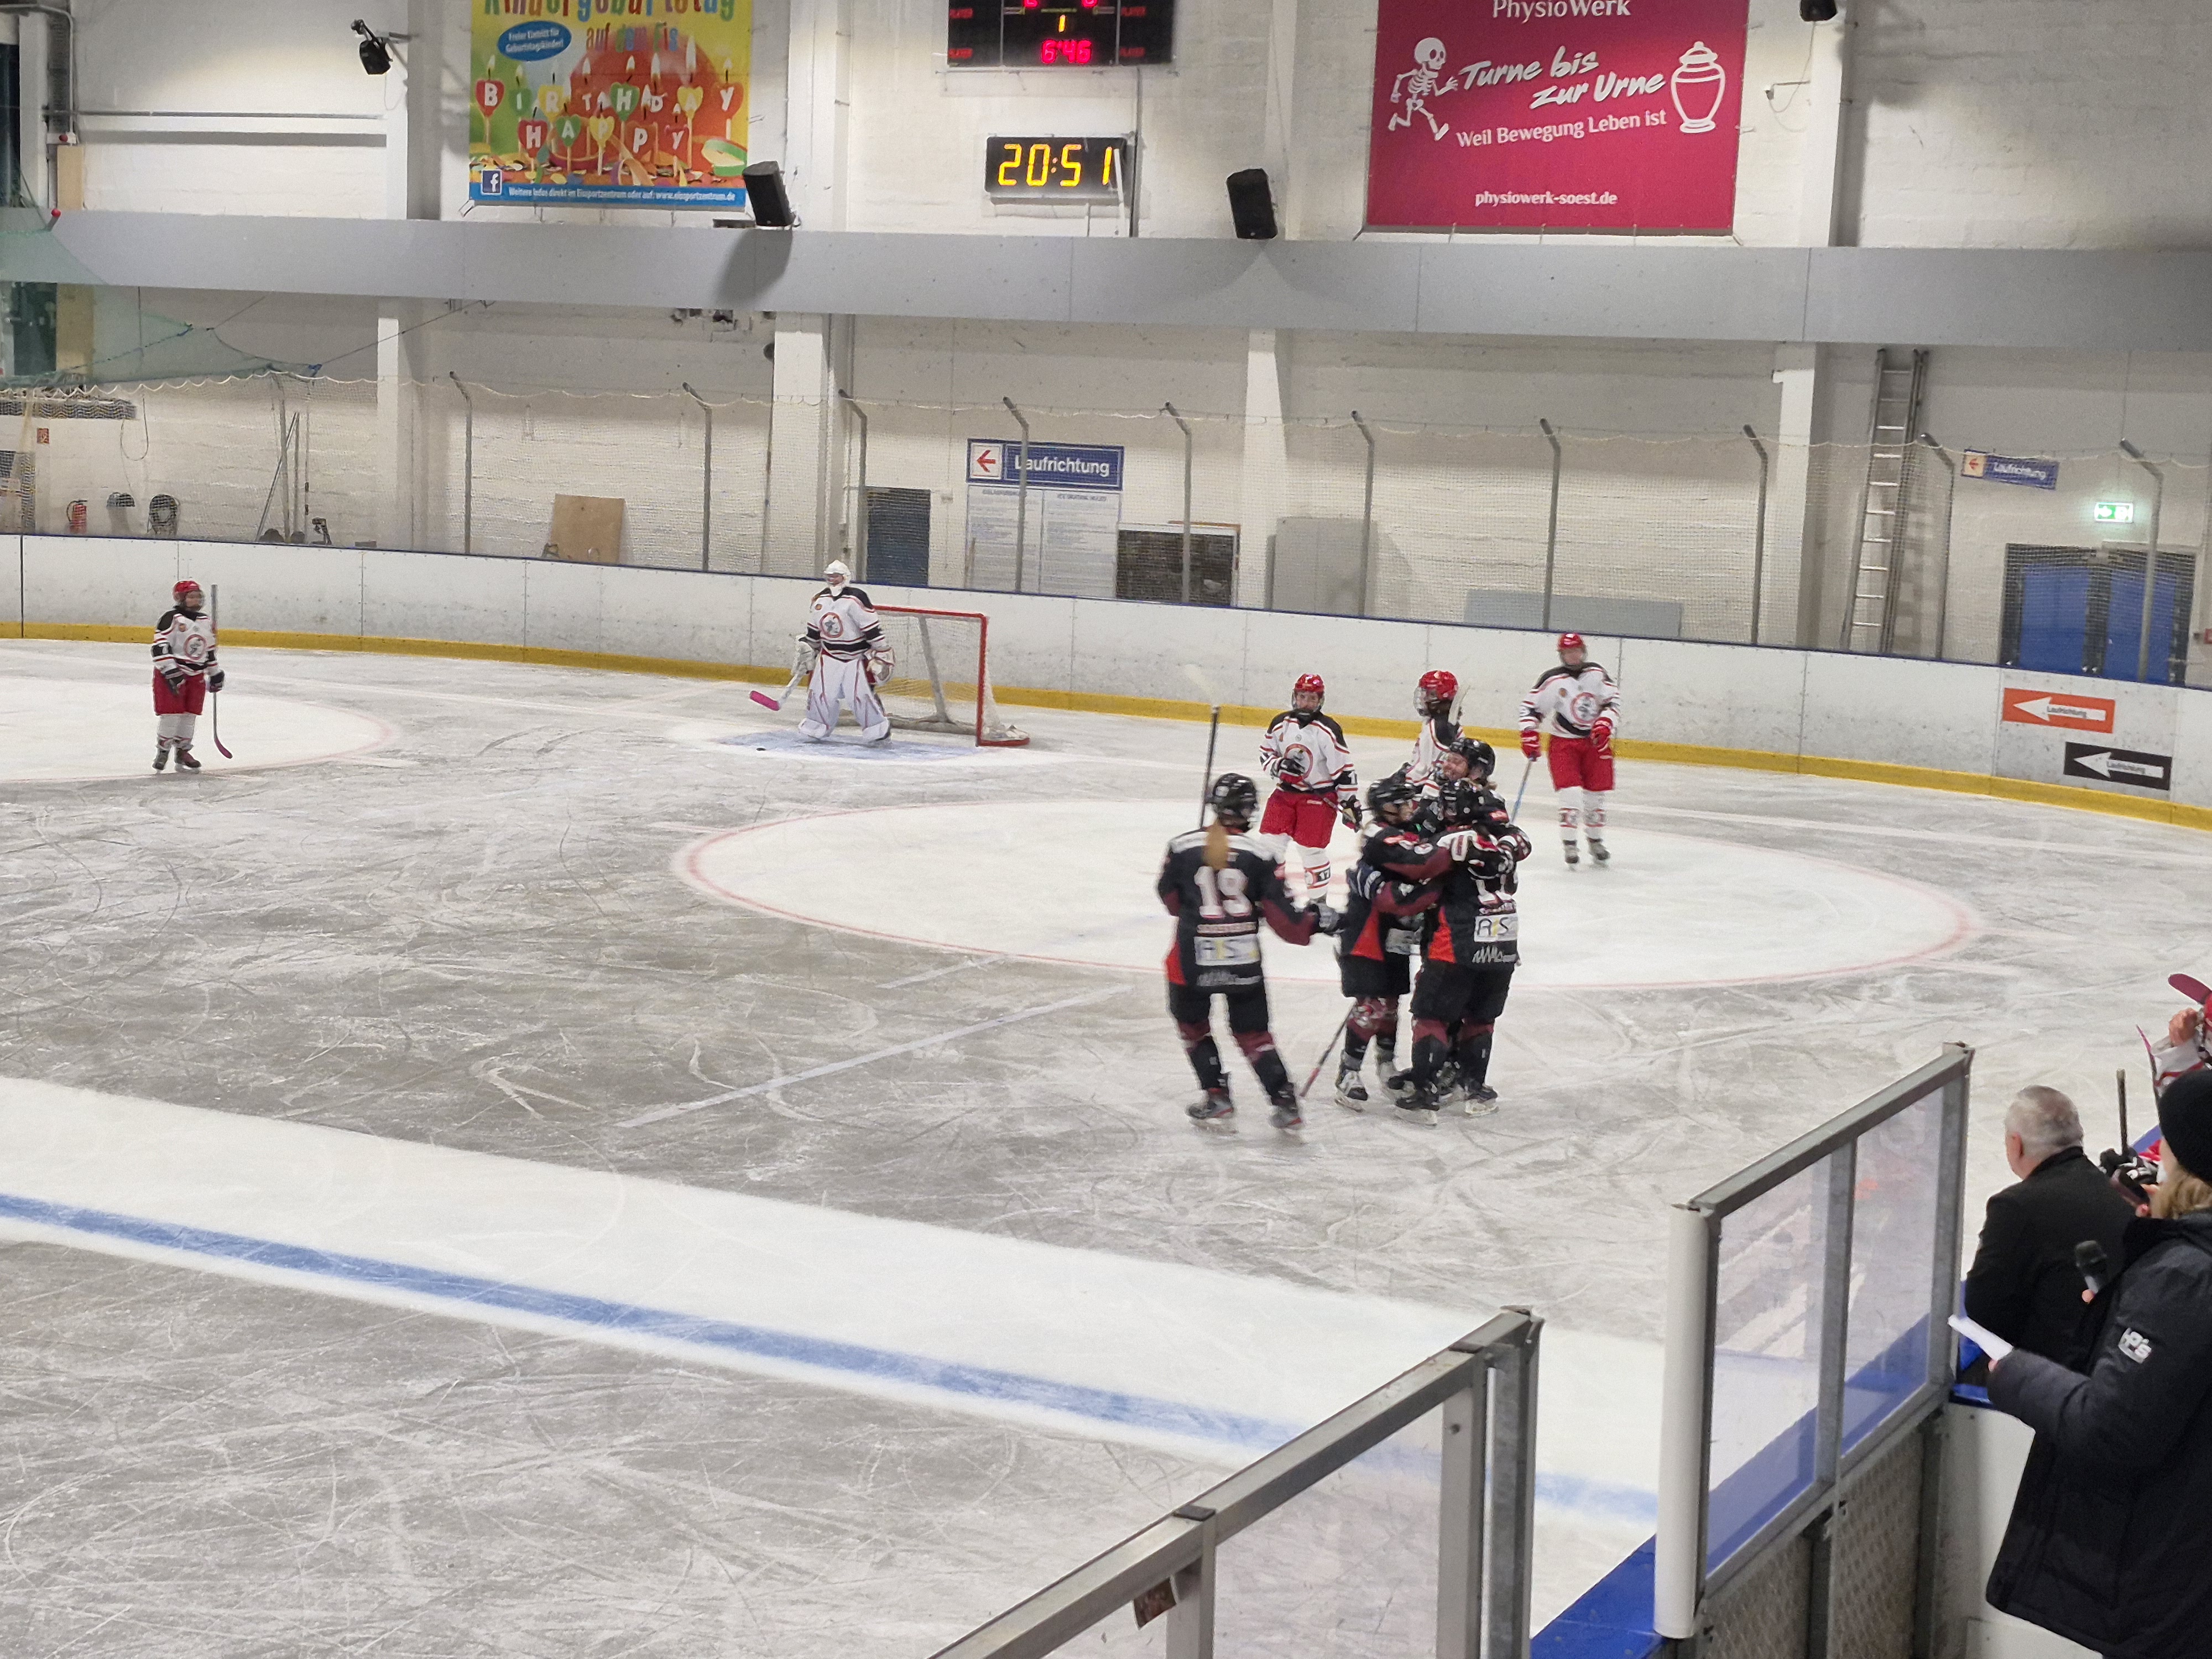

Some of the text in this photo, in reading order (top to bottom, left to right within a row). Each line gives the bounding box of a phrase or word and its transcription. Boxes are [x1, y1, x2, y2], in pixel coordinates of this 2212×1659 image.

[1493, 0, 1631, 24] PhysioWerk
[586, 22, 678, 53] auf dem Eis
[1458, 45, 1599, 90] Turne bis
[1529, 71, 1666, 109] zur Urne
[1456, 109, 1667, 147] Weil Bewegung Leben ist
[998, 143, 1112, 186] 20:51
[1475, 190, 1618, 207] physiowerk-soest.de
[1015, 454, 1109, 477] Laufrichtung
